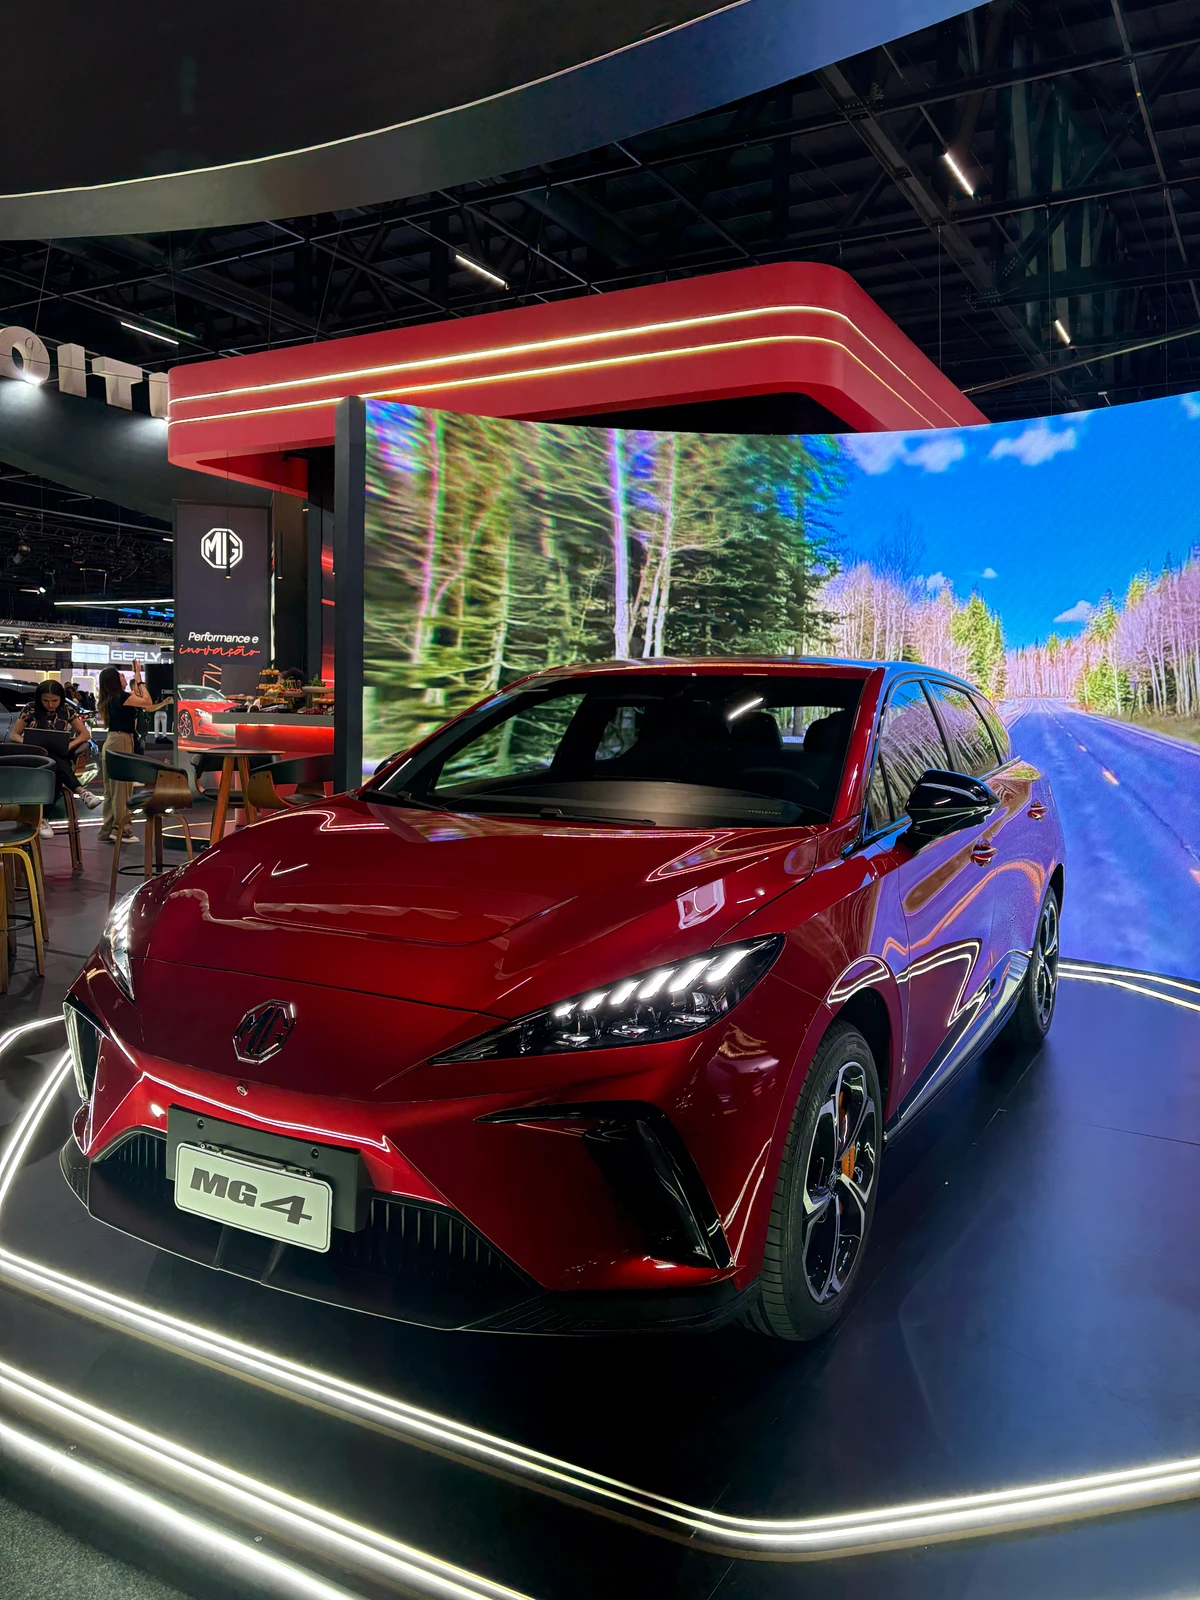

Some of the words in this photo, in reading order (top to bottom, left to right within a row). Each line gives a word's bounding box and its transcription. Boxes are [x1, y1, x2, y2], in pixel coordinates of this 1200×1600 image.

[204, 530, 240, 566] MG
[188, 631, 250, 643] Performance
[251, 635, 259, 644] e
[110, 649, 161, 662] GEELY
